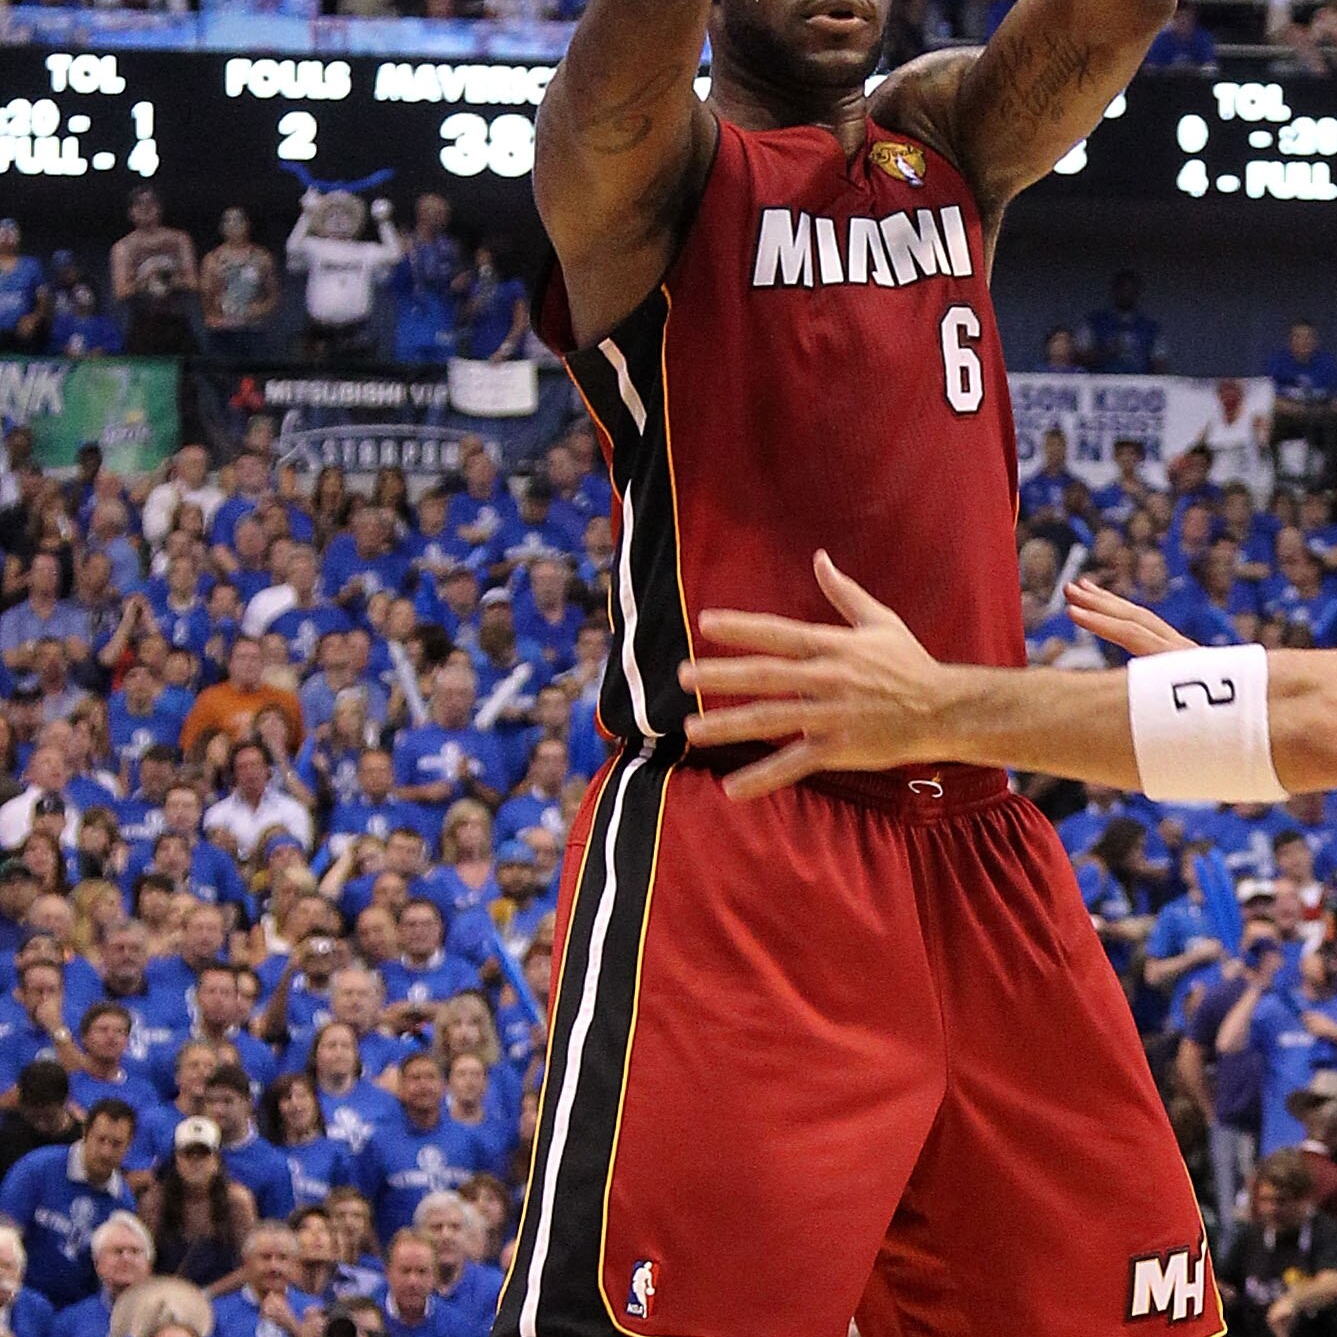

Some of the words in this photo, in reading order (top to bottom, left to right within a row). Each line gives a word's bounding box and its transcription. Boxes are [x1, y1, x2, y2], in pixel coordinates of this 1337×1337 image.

[46, 53, 126, 95] TOL
[225, 58, 353, 101] FOULS
[373, 62, 560, 106] MAVERIC
[1213, 81, 1292, 122] TOL
[277, 111, 319, 161] 2
[127, 137, 160, 178] 4
[1176, 158, 1210, 198] 4
[752, 204, 973, 288] MIAMI
[940, 305, 984, 413] 6
[1172, 677, 1236, 712] 2
